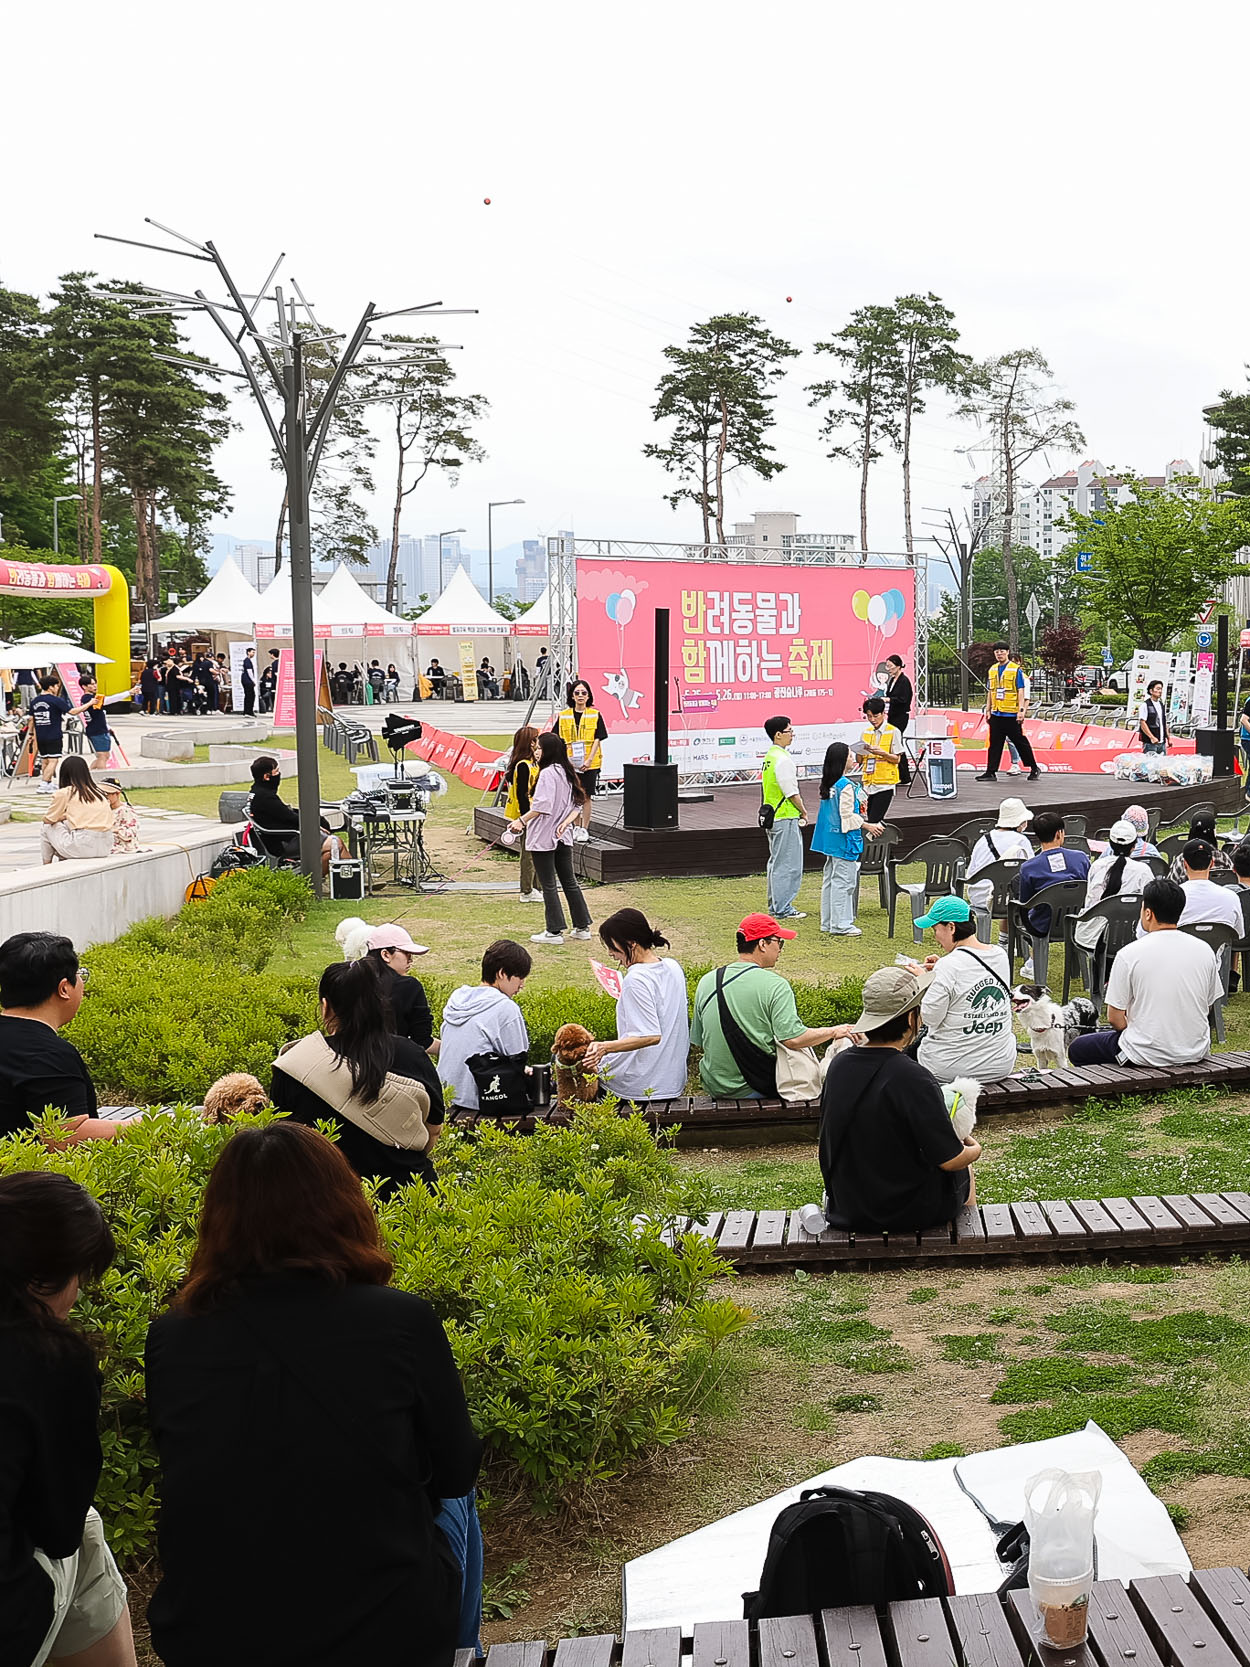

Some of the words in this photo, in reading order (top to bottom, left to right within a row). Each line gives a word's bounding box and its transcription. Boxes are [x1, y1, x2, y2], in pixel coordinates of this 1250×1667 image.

[681, 590, 802, 635] 반려동물과
[681, 639, 783, 684] 함께하는
[787, 638, 833, 682] 축제
[927, 741, 942, 756] 1등
[965, 977, 994, 1003] RUGGED
[962, 1020, 1003, 1036] Jeep
